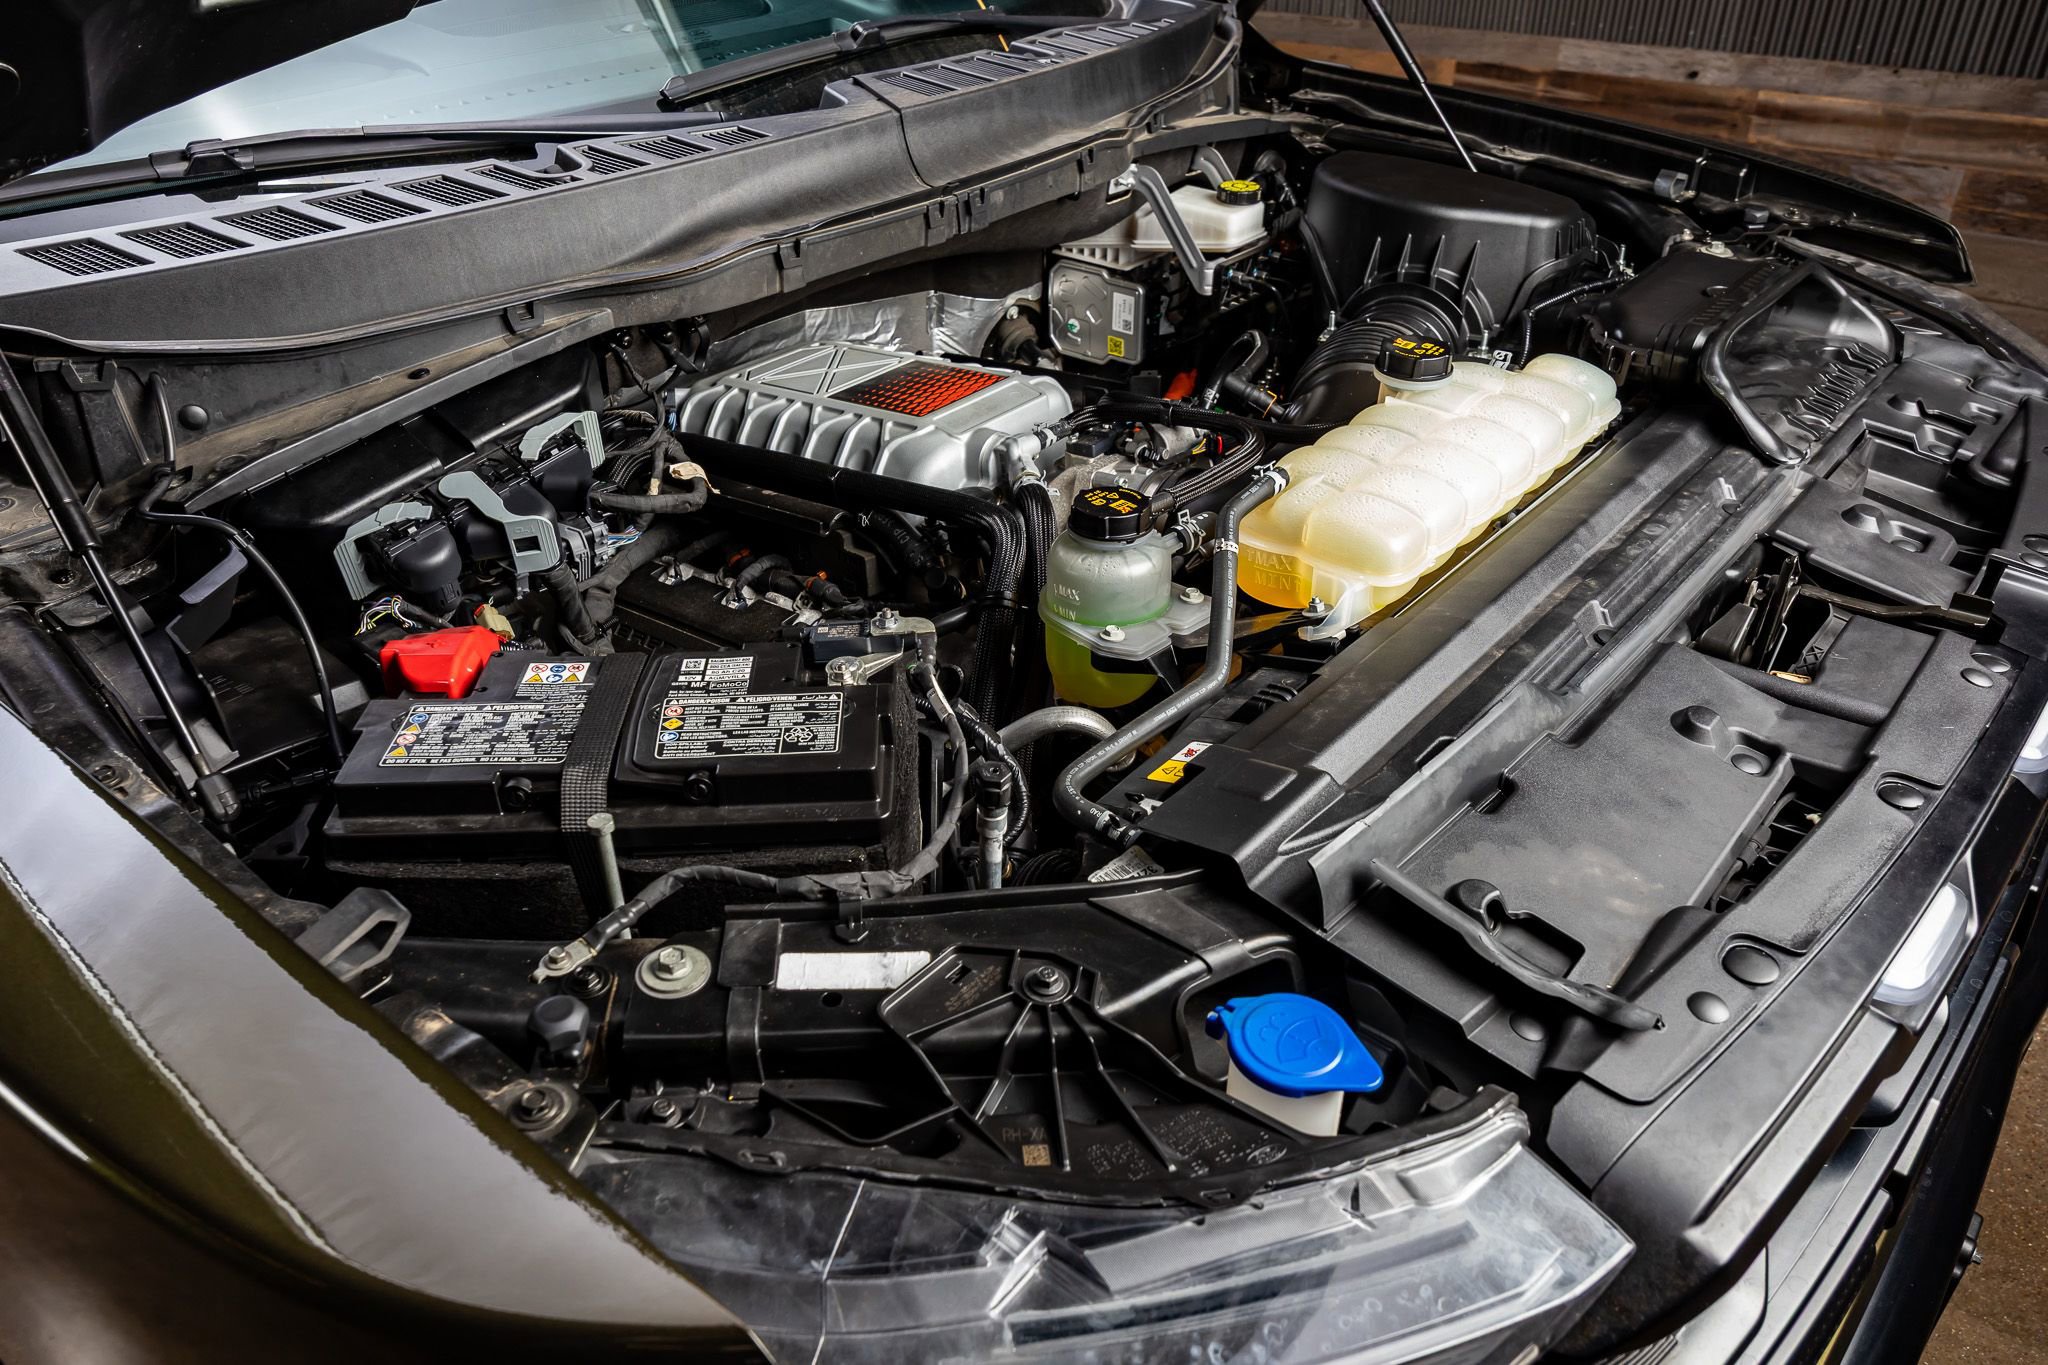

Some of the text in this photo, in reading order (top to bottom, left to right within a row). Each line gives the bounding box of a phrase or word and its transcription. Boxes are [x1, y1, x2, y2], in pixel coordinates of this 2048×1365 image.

[1255, 549, 1292, 571] MAX
[1255, 571, 1292, 591] MIN
[1059, 584, 1080, 601] MAX
[1059, 606, 1076, 621] MIN
